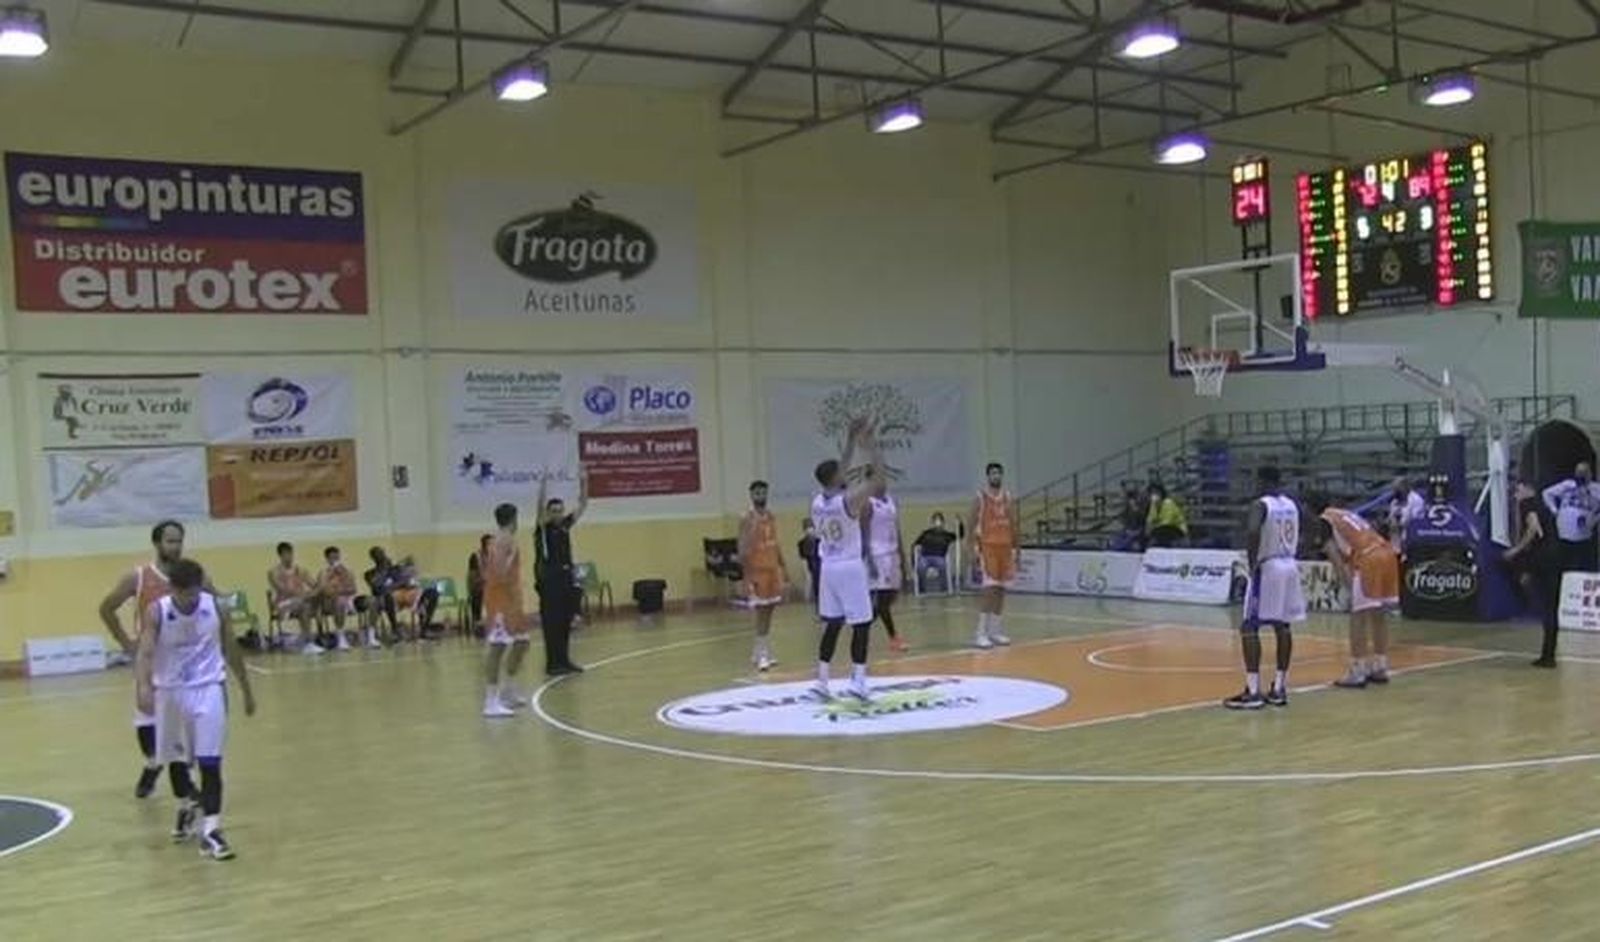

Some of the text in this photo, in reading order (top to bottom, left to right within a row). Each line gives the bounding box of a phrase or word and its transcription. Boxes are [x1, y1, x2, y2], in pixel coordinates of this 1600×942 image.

[17, 170, 355, 222] europinturas
[1236, 186, 1264, 219] 24
[34, 239, 206, 263] Distribuidor
[504, 217, 647, 272] Fragata
[58, 260, 342, 311] eurotex
[523, 290, 637, 313] Aceitunas
[80, 396, 192, 415] Cruz Verde
[629, 385, 692, 410] Placo
[250, 444, 339, 464] REPSOL
[584, 439, 694, 456] Medina Torres
[1412, 561, 1472, 593] Fragata
